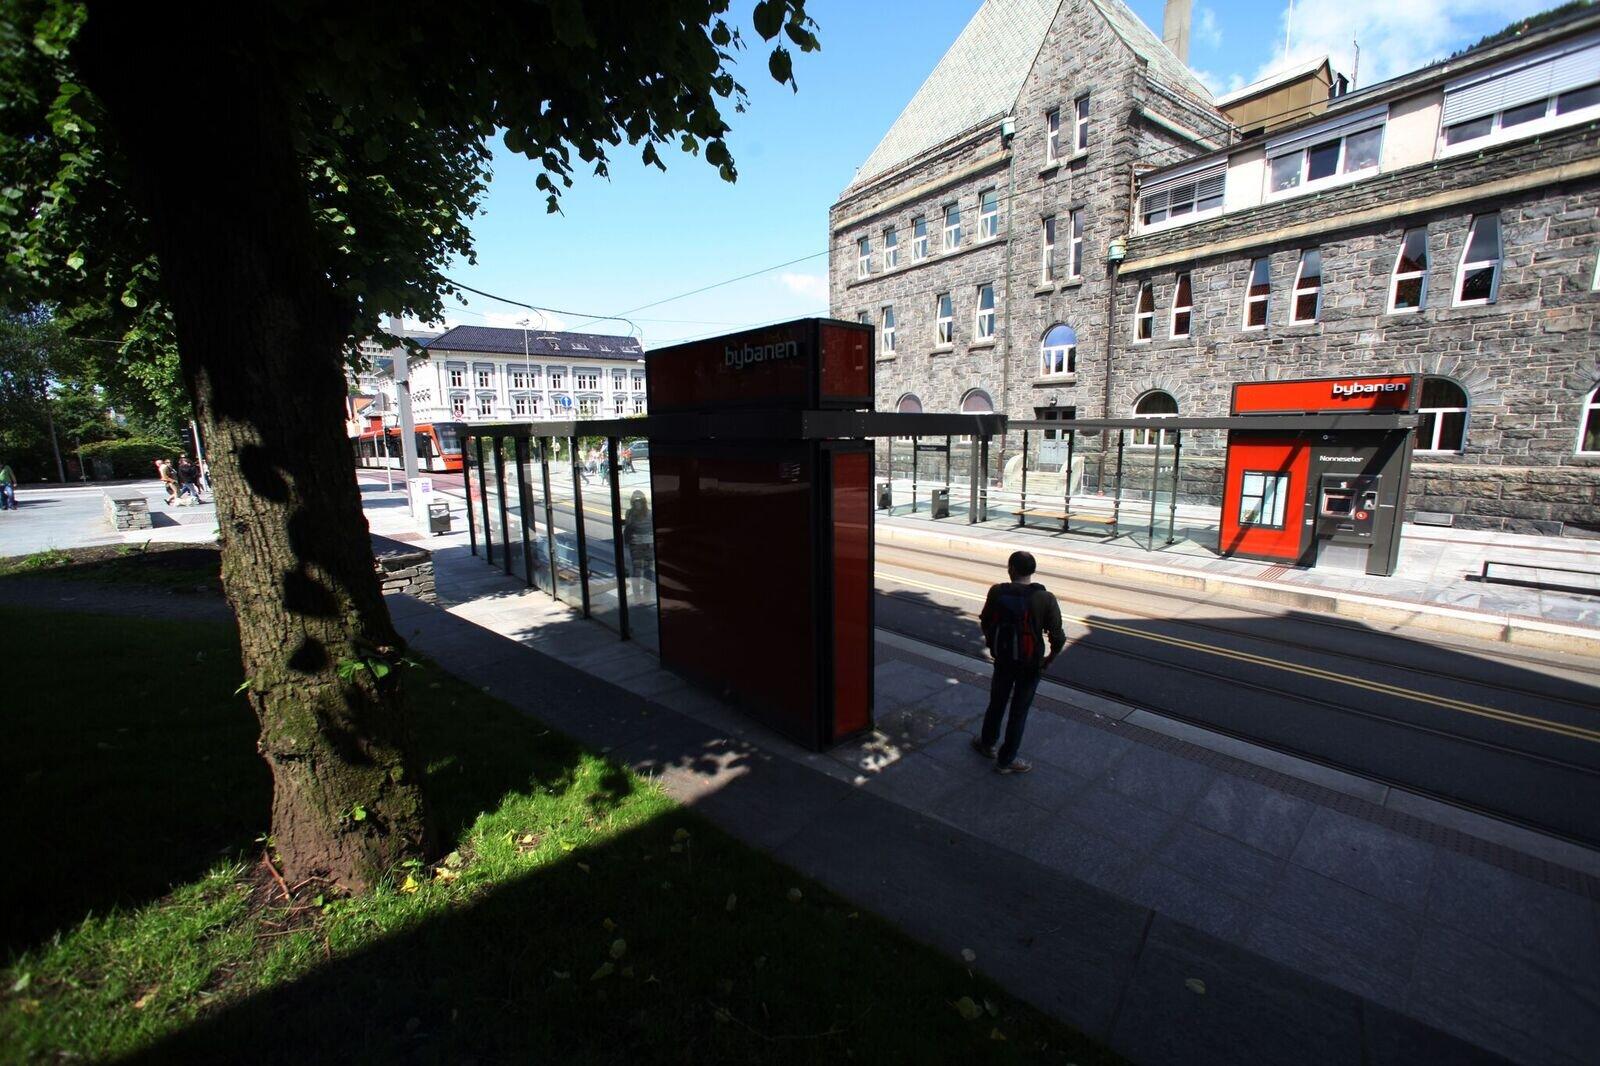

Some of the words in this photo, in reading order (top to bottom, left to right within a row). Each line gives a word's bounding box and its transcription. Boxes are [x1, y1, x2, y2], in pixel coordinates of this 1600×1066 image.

[725, 340, 798, 369] bybanen
[1333, 382, 1406, 396] bybanen
[1319, 455, 1364, 463] Nonneseter
